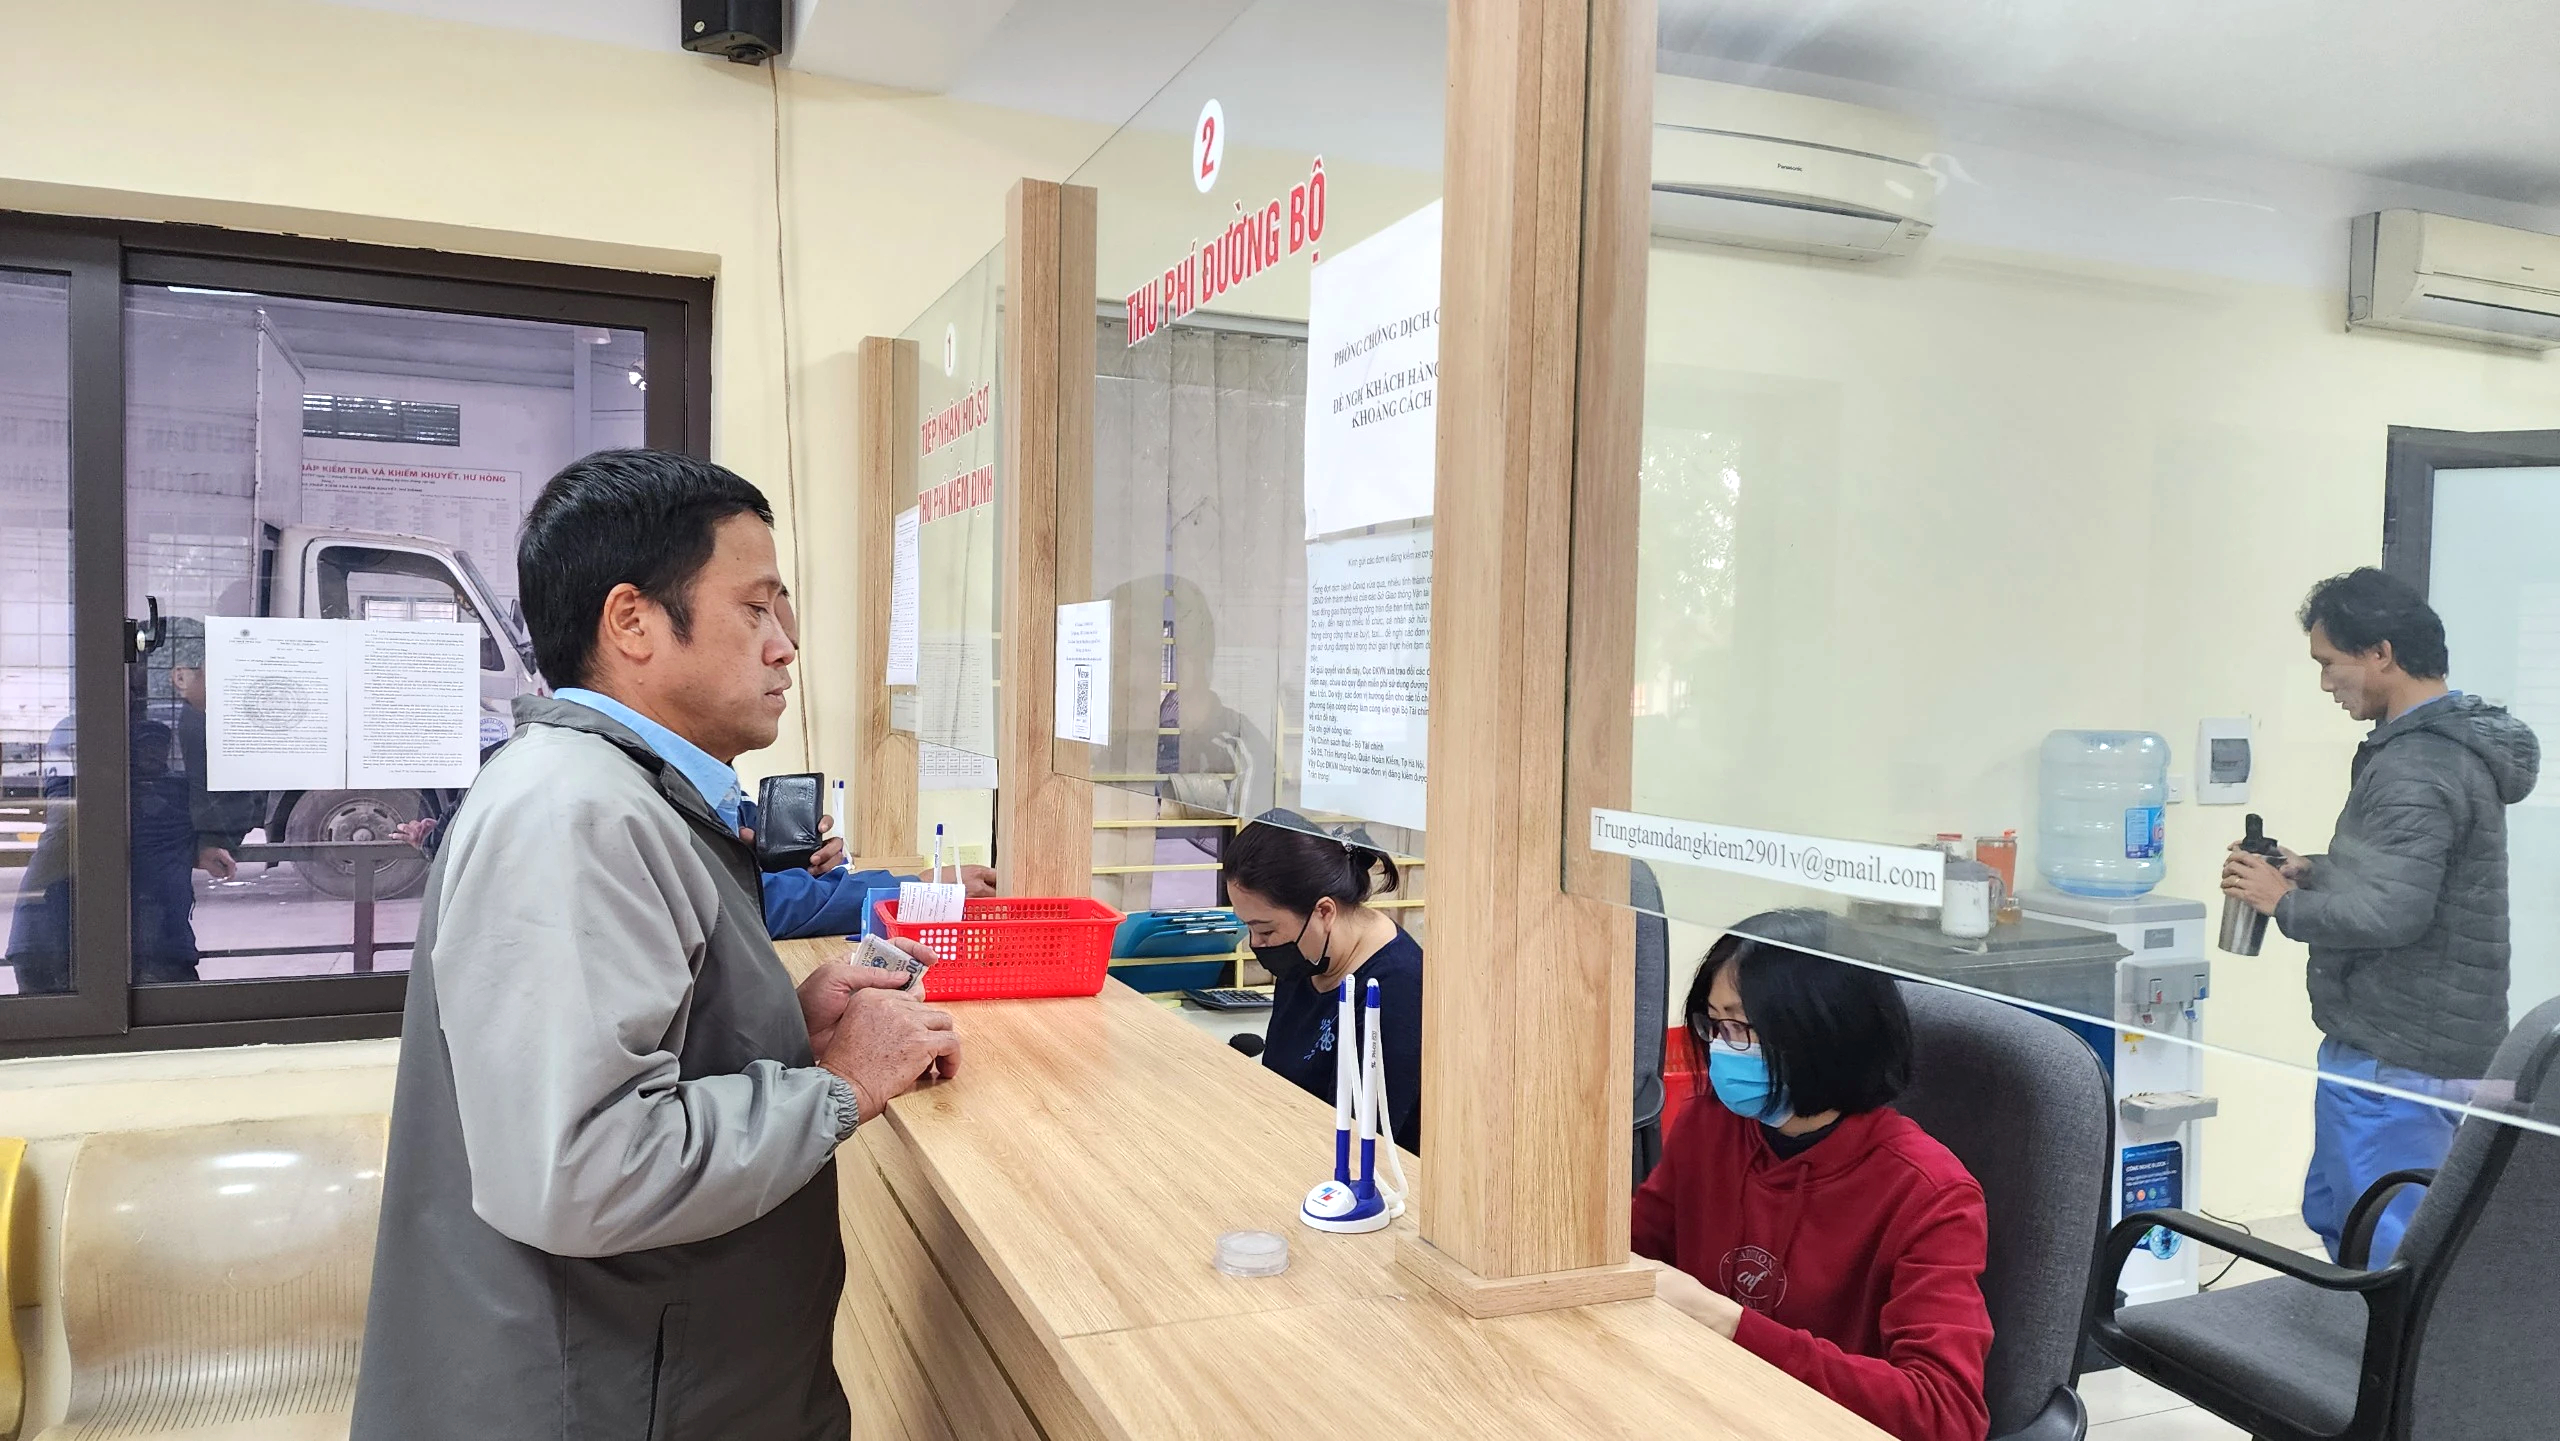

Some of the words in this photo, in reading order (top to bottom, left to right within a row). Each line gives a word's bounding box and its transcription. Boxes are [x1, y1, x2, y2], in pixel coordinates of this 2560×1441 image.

[1200, 116, 1215, 180] 2
[1777, 163, 1803, 172] Panasonic
[1127, 277, 1159, 348] THU
[1164, 238, 1196, 327] PHÍ
[1201, 198, 1281, 305] ĐƯỜNG
[1288, 154, 1328, 262] BỘ
[1400, 310, 1431, 338] DỊCH
[947, 333, 952, 368] 1
[1366, 371, 1405, 399] KHÁCH
[921, 406, 937, 457] TIẾP
[938, 398, 960, 454] NHẬN
[963, 381, 975, 437] HỒ
[976, 380, 990, 429] SƠ
[1352, 400, 1397, 429] KHOẢNG
[1399, 389, 1433, 414] CÁCH
[349, 466, 369, 475] TRA
[918, 489, 932, 526] THU
[933, 473, 947, 518] PHÍ
[948, 460, 969, 516] KIỂM
[971, 463, 994, 518] ĐỊNH
[1594, 814, 1938, 892] Trungtamdangkiem2901v@gmail.com
